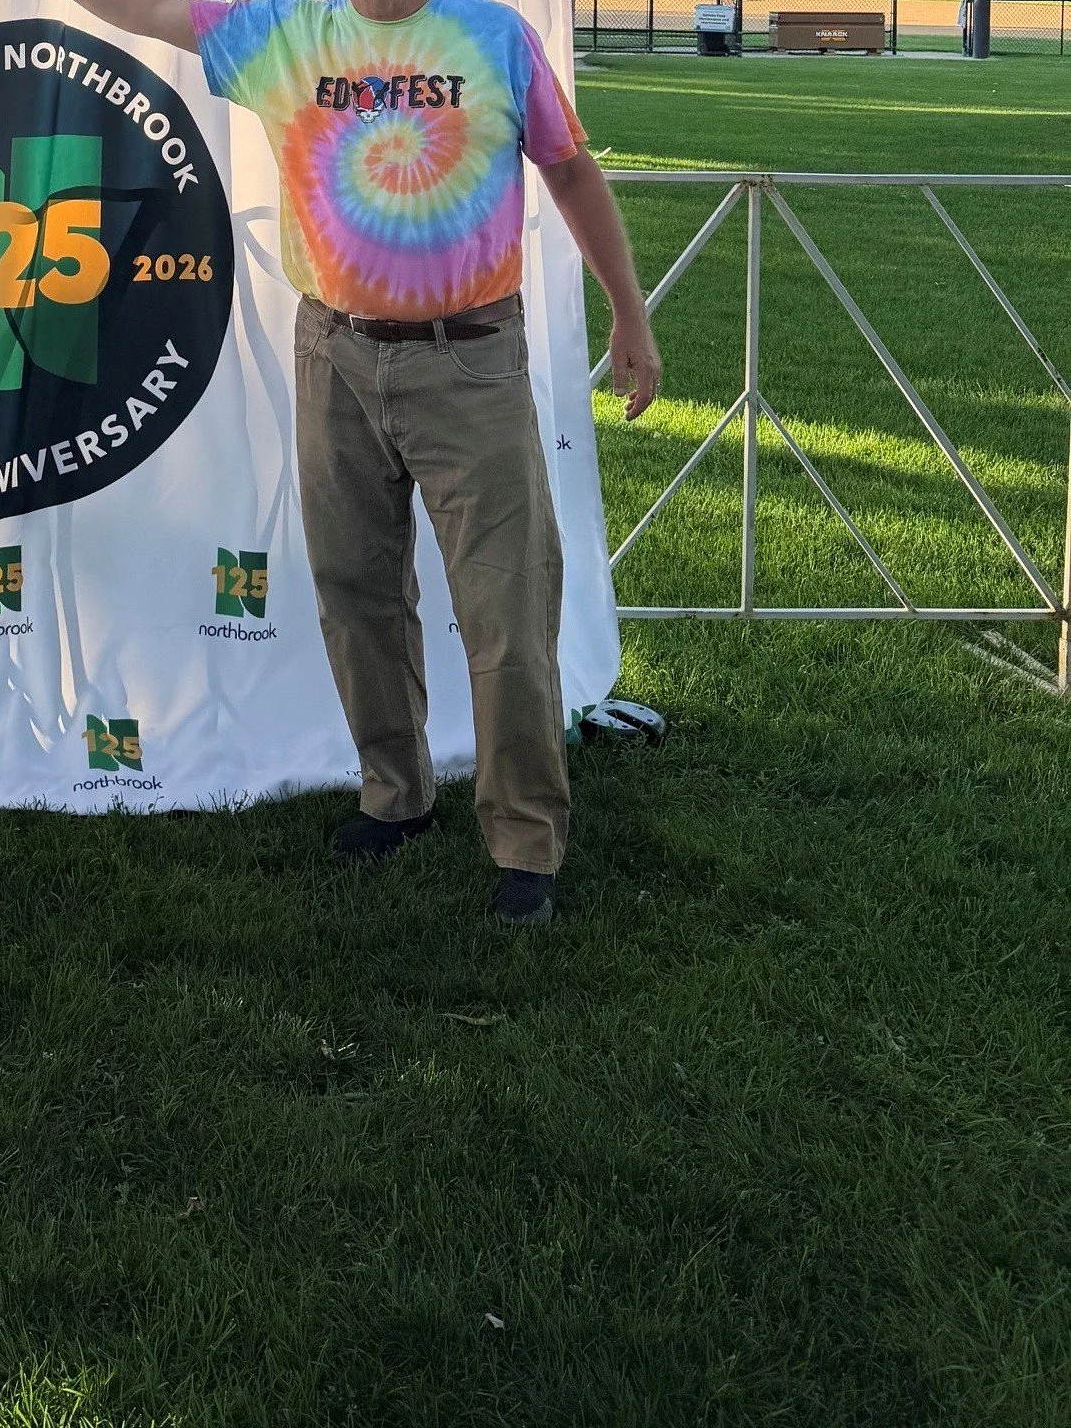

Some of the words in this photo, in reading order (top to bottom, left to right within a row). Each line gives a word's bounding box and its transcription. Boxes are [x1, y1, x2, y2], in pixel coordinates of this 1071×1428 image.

[4, 41, 199, 193] NORTHBROOK
[132, 254, 213, 282] 2026
[212, 566, 269, 598] 125
[199, 622, 277, 641] northbrook
[82, 729, 143, 760] 125
[73, 775, 163, 791] northbrook
